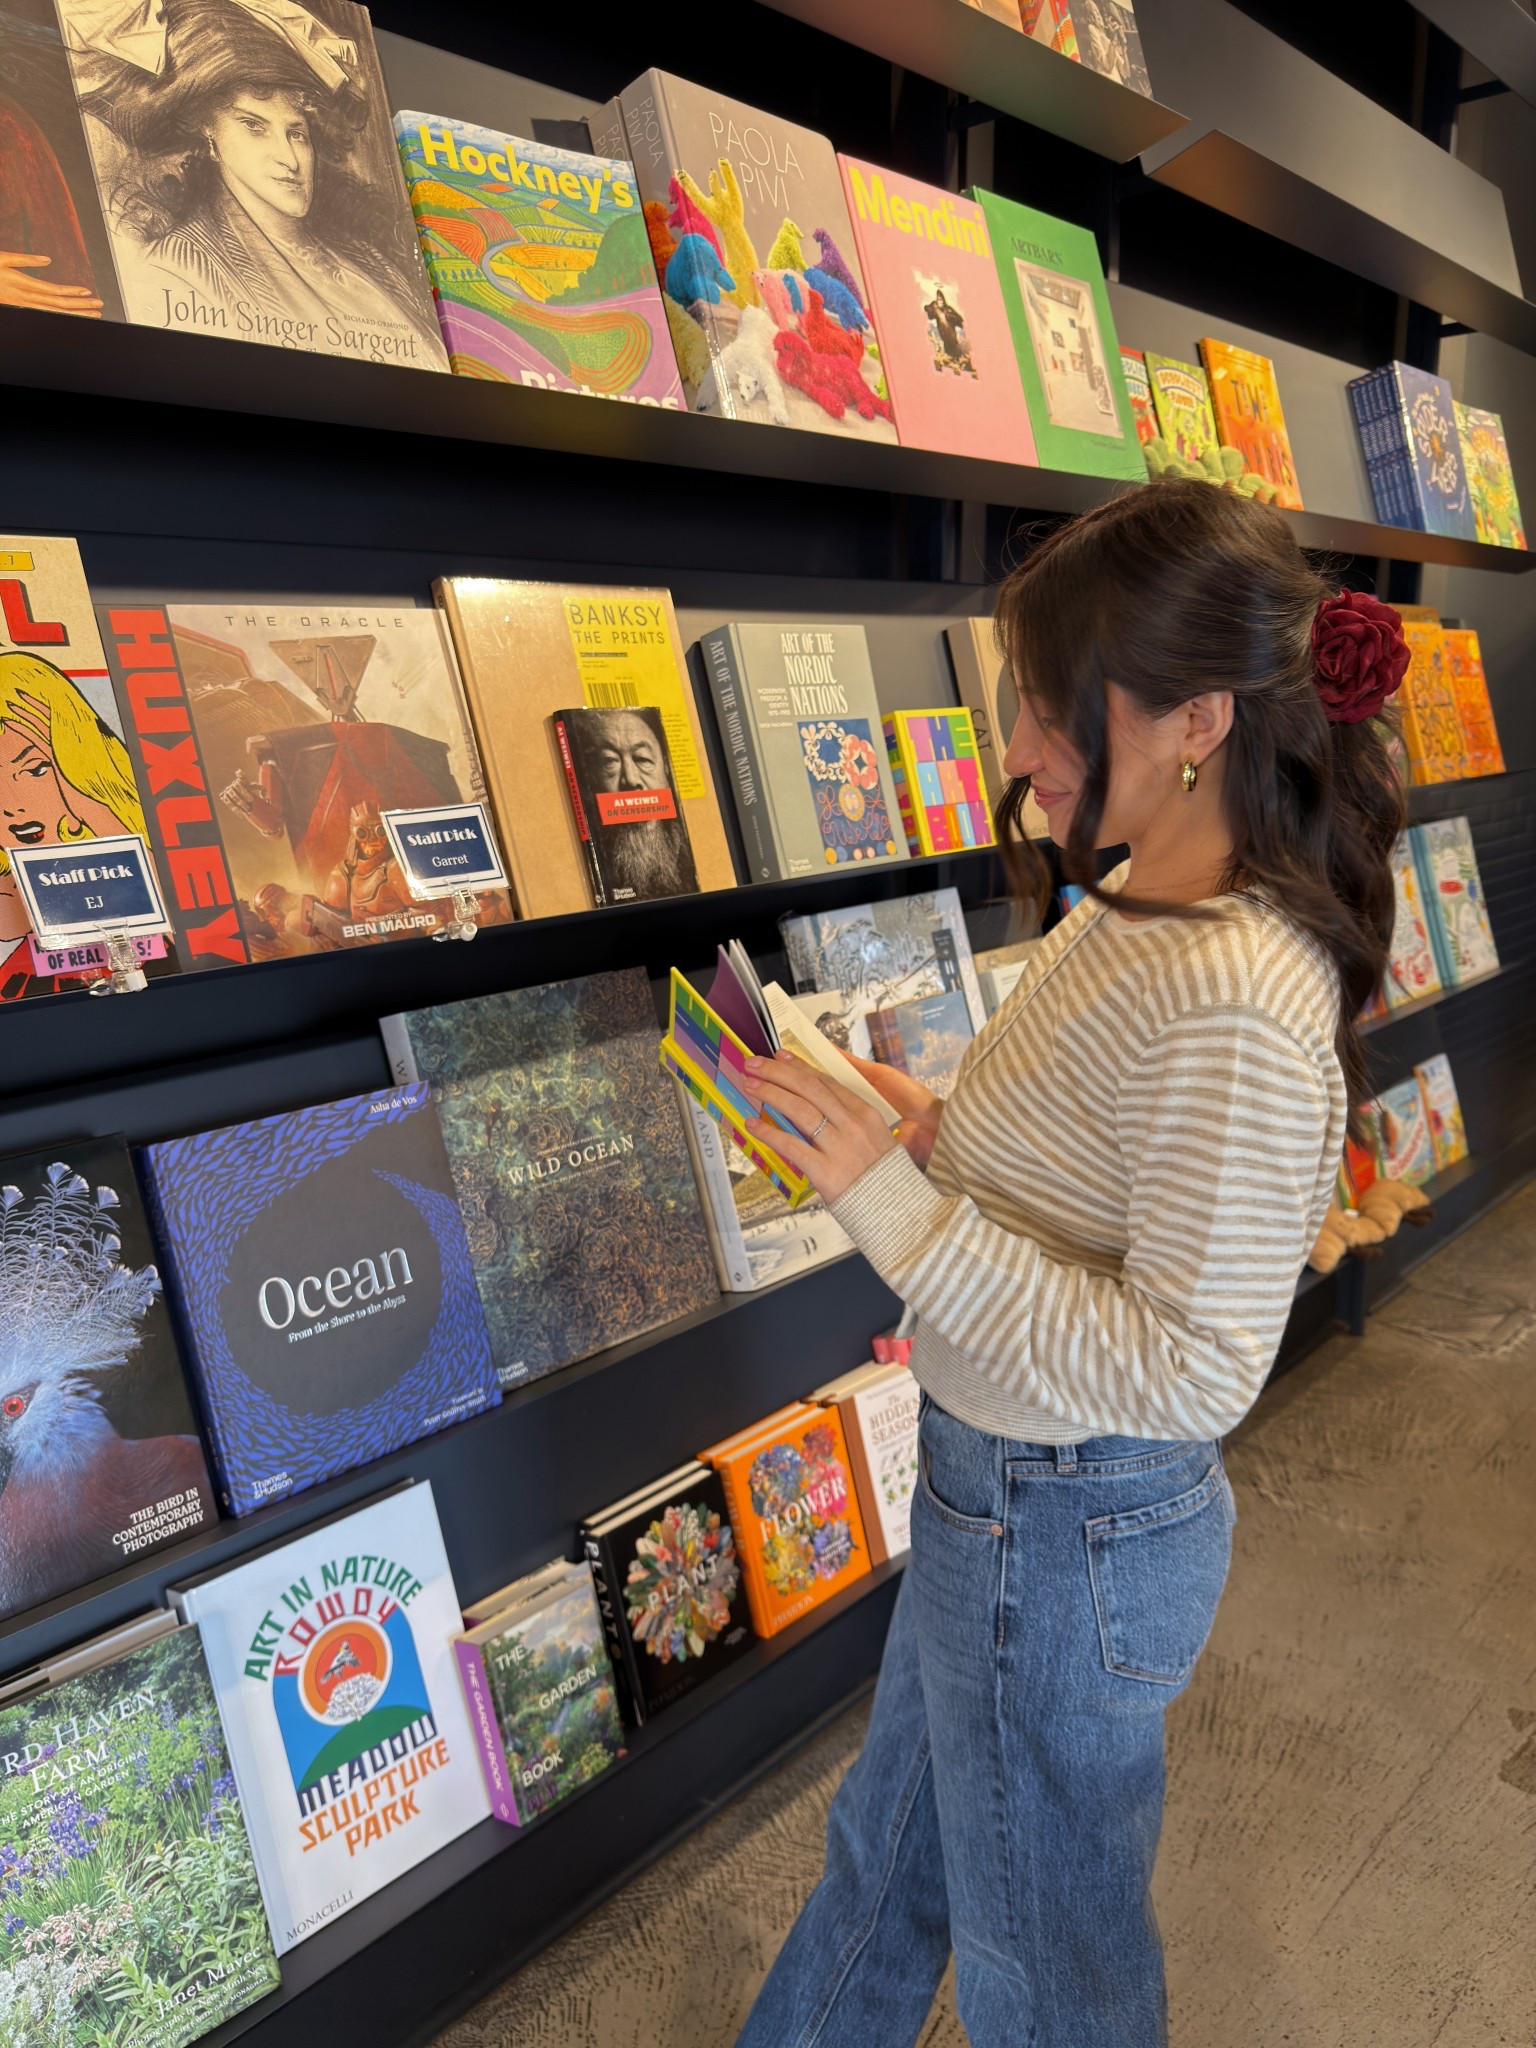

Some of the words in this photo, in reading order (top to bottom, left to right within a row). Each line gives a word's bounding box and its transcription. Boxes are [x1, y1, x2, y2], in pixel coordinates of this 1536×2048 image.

[625, 108, 644, 147] PIVI
[640, 96, 664, 167] PAOLA
[709, 112, 805, 180] PAOLA
[418, 124, 634, 214] Hockney's
[740, 162, 790, 212] PIVI
[848, 166, 990, 259] Mendini
[161, 288, 228, 328] John
[236, 300, 319, 349] Singer
[325, 316, 418, 364] Sargent
[343, 314, 376, 326] RICHARD
[377, 318, 410, 331] ORMOND
[225, 616, 277, 627] THE
[301, 616, 405, 628] ORACLE
[569, 604, 661, 626] BANKSY
[573, 631, 602, 643] THE
[612, 632, 665, 645] PRINTS
[709, 640, 727, 666] ART
[781, 633, 800, 654] ART
[801, 633, 814, 654] OF
[814, 633, 836, 654] THE
[715, 667, 731, 683] OF
[783, 654, 838, 685] NORDIC
[720, 684, 737, 711] THE
[789, 684, 849, 716] NATIONS
[726, 709, 747, 755] NORDIC
[108, 609, 248, 964] HUXLEY
[614, 798, 624, 807] AI
[624, 796, 660, 806] WEIWEI
[735, 757, 758, 806] NATIONS
[607, 809, 618, 817] ON
[620, 805, 669, 816] CENSORSHIP
[407, 831, 442, 847] Staff
[443, 828, 478, 843] Pick
[38, 867, 86, 888] Staff
[87, 864, 134, 883] Pick
[432, 854, 469, 868] Garret
[84, 895, 104, 910] EJ
[342, 924, 379, 939] BEN
[380, 914, 437, 933] MAURO
[47, 953, 65, 970] OF
[69, 948, 104, 967] REAL
[370, 1100, 390, 1114] Asha
[391, 1098, 402, 1108] de
[402, 1095, 418, 1106] Vos
[507, 1157, 561, 1185] WILD
[568, 1134, 634, 1167] OCEAN
[258, 1247, 414, 1330] Ocean
[288, 1326, 313, 1344] From
[314, 1321, 329, 1335] the
[330, 1312, 355, 1329] Shore
[355, 1309, 367, 1319] to
[367, 1303, 382, 1315] the
[382, 1294, 406, 1312] Abyss
[251, 1471, 288, 1490] Thames
[254, 1477, 293, 1500] &Hudson
[112, 1499, 201, 1546] CONTEMPORARY
[129, 1506, 155, 1525] THE
[156, 1494, 185, 1513] BIRD
[186, 1487, 199, 1500] IN
[759, 1476, 847, 1545] FLOWER
[122, 1510, 205, 1555] PHOTOGRAPHY
[647, 1553, 719, 1612] PLANT
[244, 1609, 285, 1682] ART
[280, 1576, 314, 1614] IN
[320, 1555, 423, 1607] NATURE
[274, 1587, 399, 1676] ROWDY
[495, 1644, 526, 1672] THE
[538, 1663, 598, 1710] GARDEN
[52, 1687, 156, 1751] HAVEN
[466, 1661, 480, 1690] THE
[473, 1689, 494, 1751] GARDEN
[487, 1751, 504, 1792] BOOK
[20, 1793, 59, 1818] STORY
[61, 1784, 77, 1797] OF
[80, 1775, 95, 1788] AN
[97, 1749, 150, 1777] ORIGINAL
[28, 1740, 110, 1796] FARM
[298, 1713, 438, 1819] MEADOW
[521, 1749, 565, 1787] BOOK
[22, 1794, 82, 1829] AMERICAN
[85, 1769, 130, 1797] GARDEN
[298, 1738, 450, 1853] SCULPTURE
[344, 1789, 421, 1857] PARK
[286, 1890, 355, 1942] MONACELLI
[155, 1980, 203, 2022] Janet
[205, 1946, 262, 1986] Mavec
[229, 1975, 268, 2003] MONAGHAN
